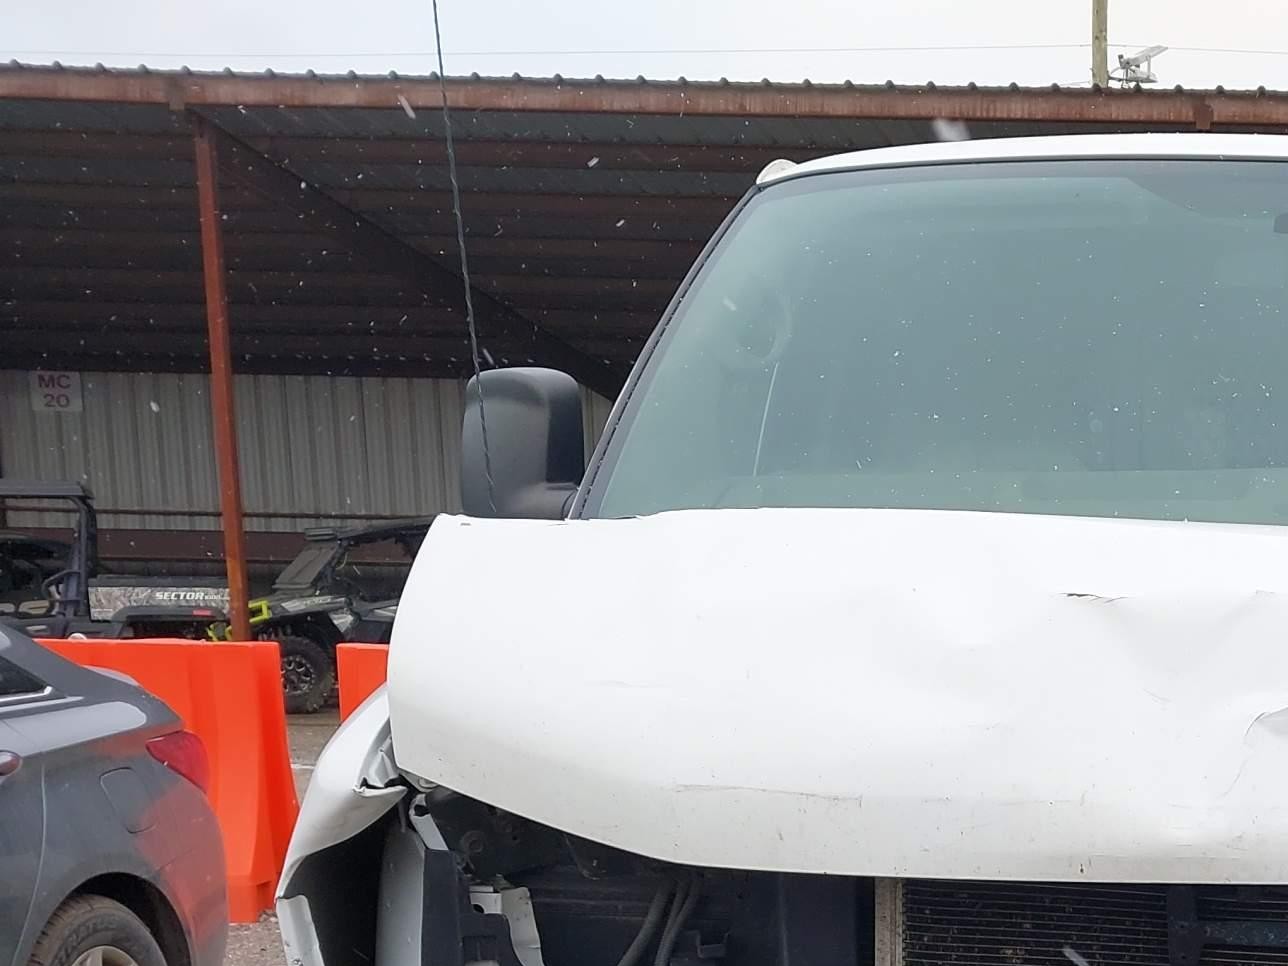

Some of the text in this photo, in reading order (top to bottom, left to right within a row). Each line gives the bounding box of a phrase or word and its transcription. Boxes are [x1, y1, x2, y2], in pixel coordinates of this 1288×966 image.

[37, 374, 71, 389] MC
[43, 393, 70, 408] 20
[155, 591, 205, 600] SECTOR
